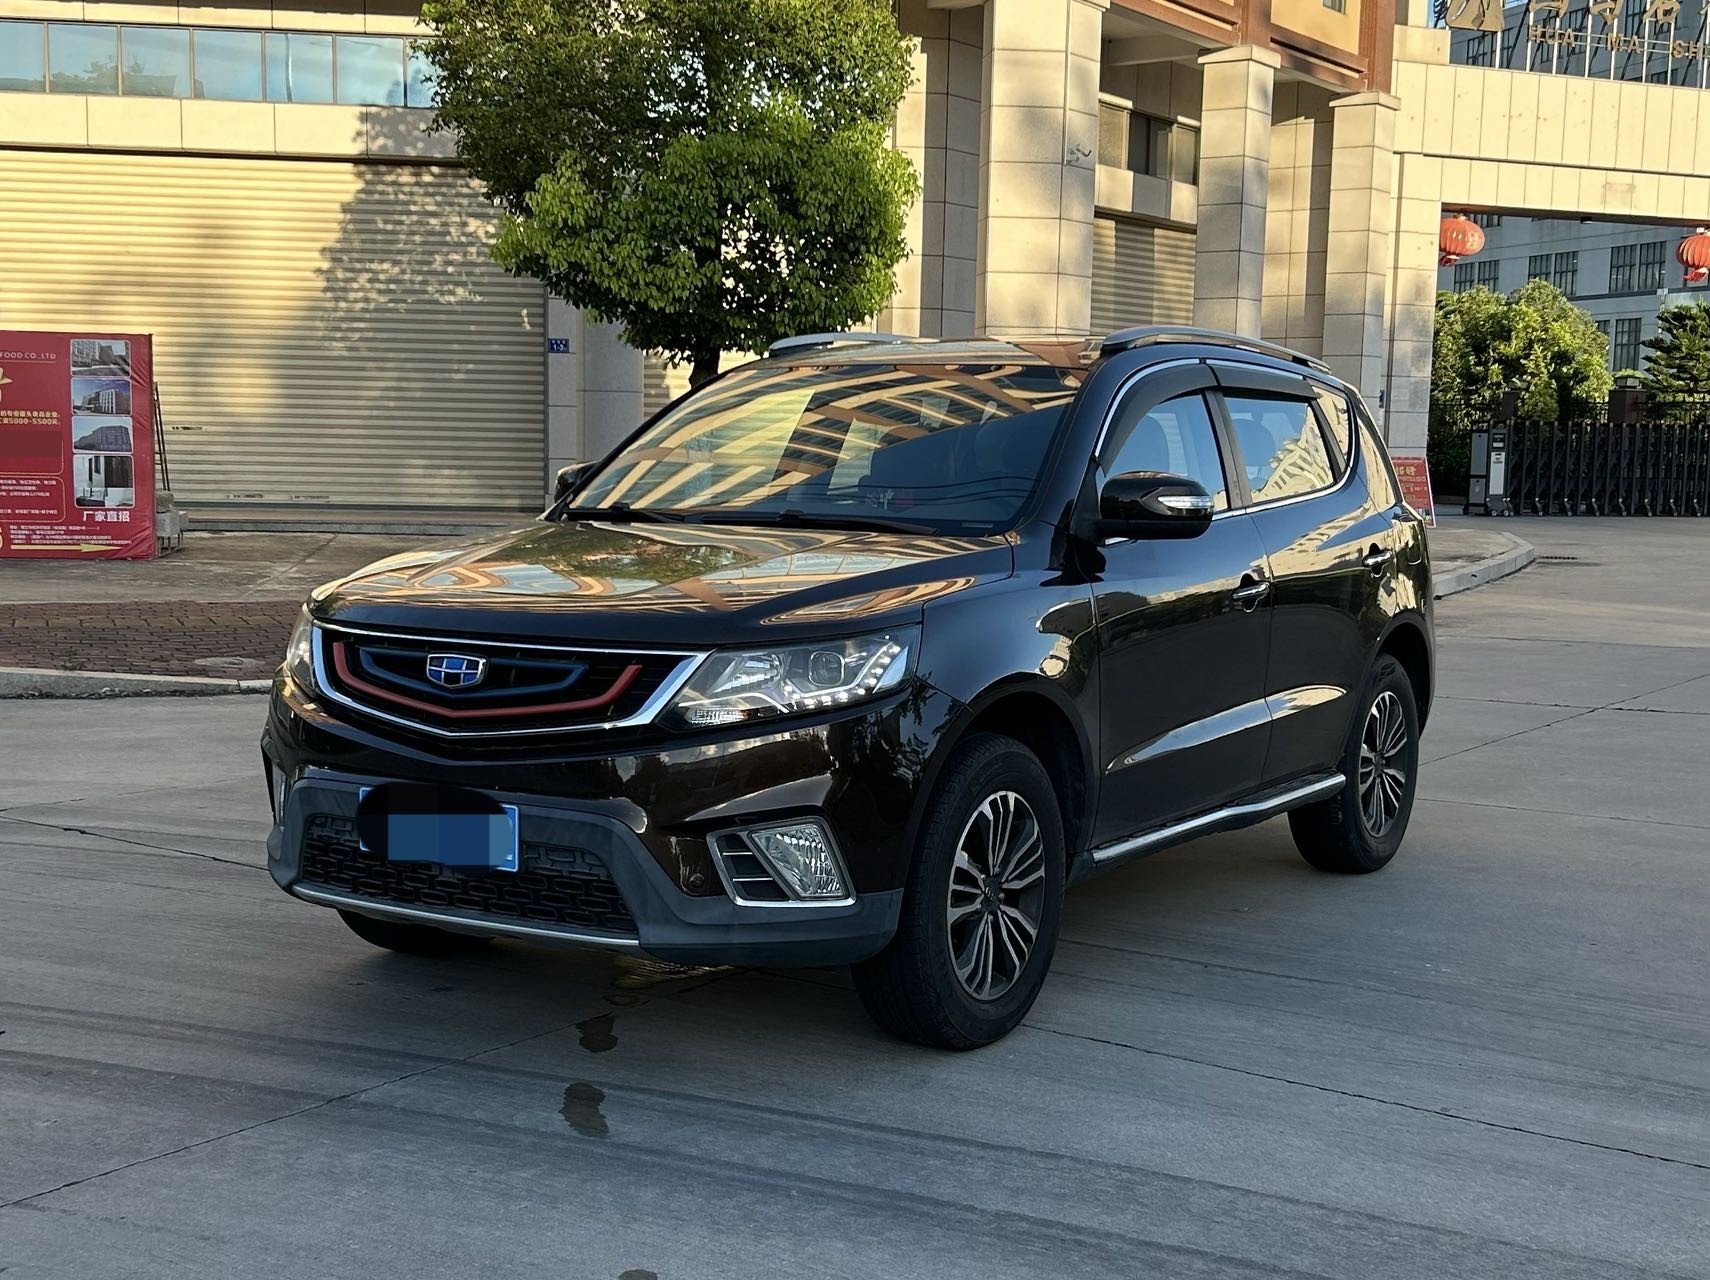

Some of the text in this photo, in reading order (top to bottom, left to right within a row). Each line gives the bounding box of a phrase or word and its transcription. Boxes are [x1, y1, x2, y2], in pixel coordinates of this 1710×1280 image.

[1528, 24, 1576, 48] HUA
[1606, 32, 1641, 55] MA
[83, 511, 130, 522] 厂家直招
